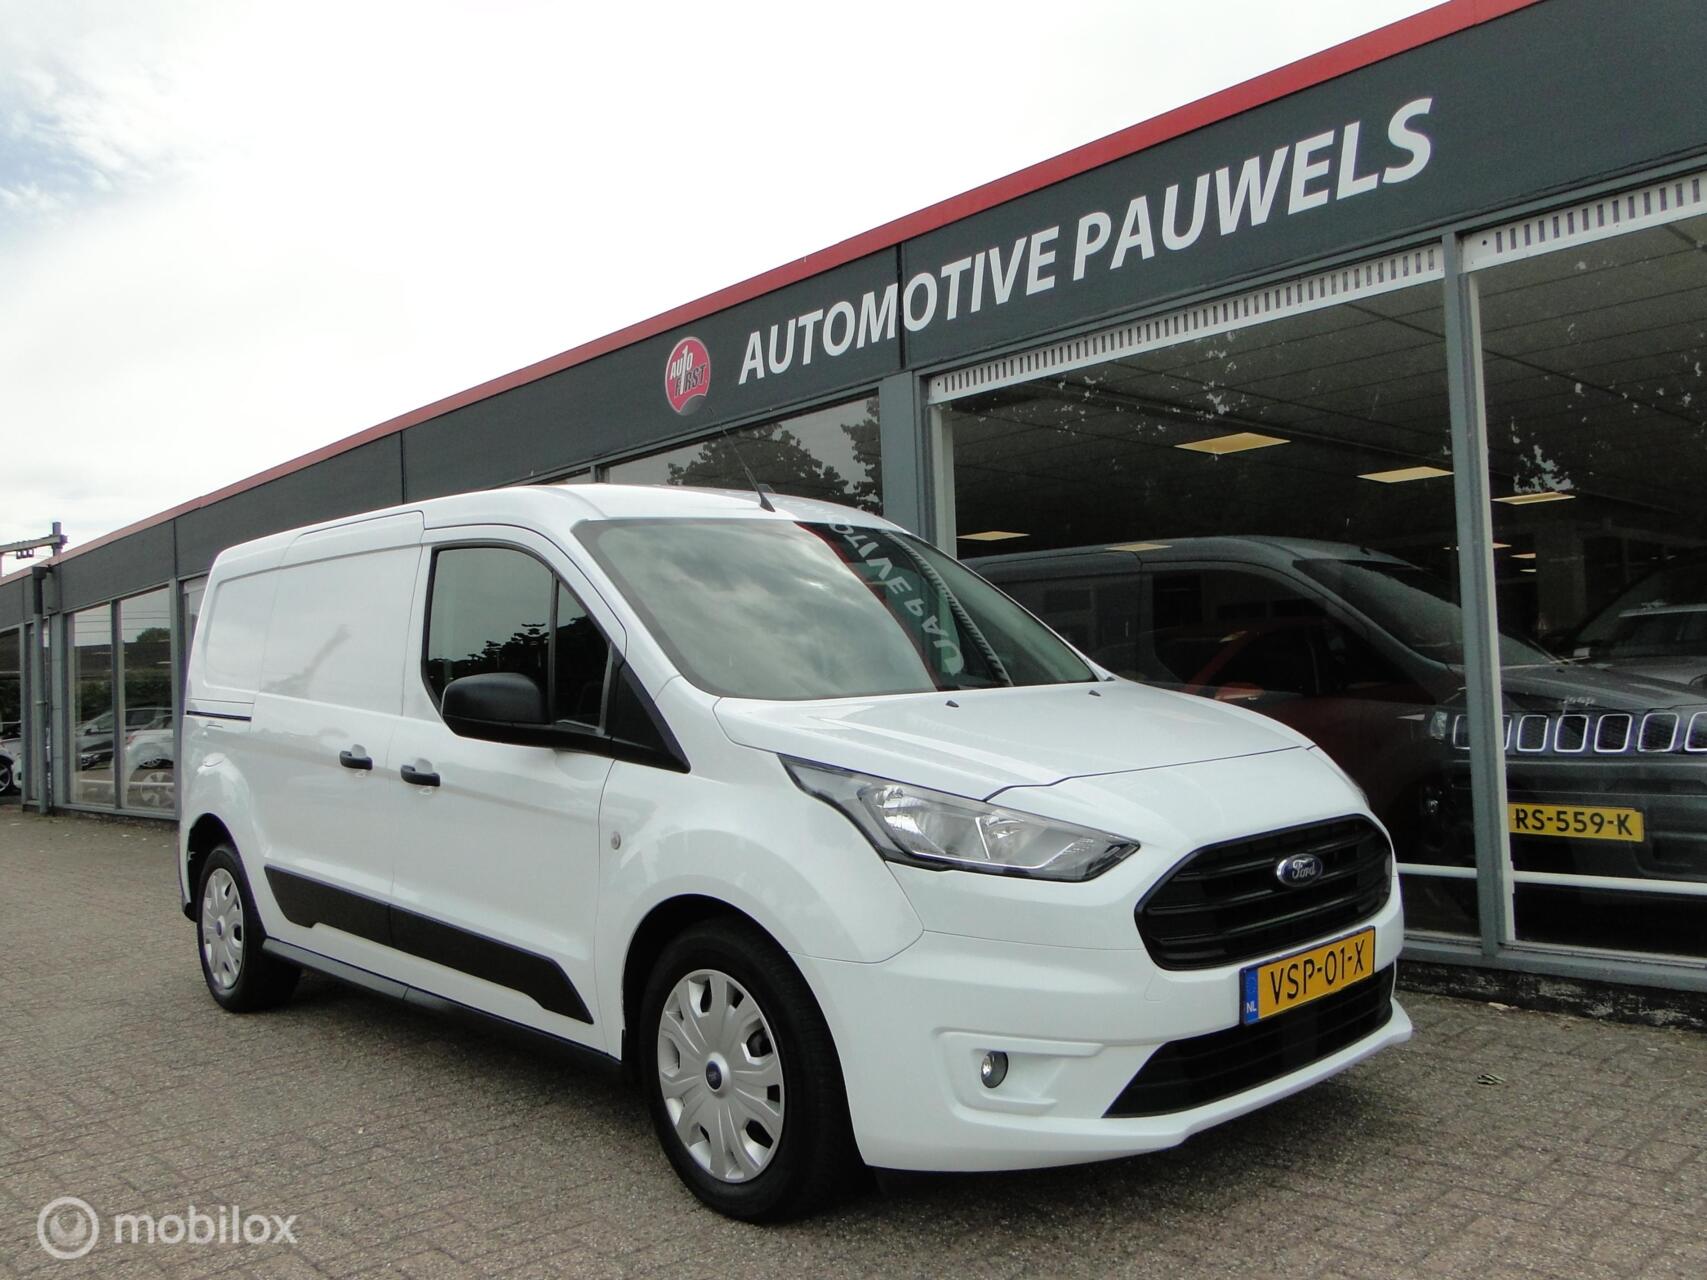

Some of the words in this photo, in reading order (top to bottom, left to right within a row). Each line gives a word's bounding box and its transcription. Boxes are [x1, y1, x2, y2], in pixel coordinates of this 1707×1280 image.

[738, 225, 1060, 385] AUTOMOTIVE
[1072, 97, 1434, 282] PAUWELS
[1515, 807, 1633, 836] RS-559-K
[1291, 857, 1316, 880] Ford
[1270, 939, 1365, 1004] VSP-01-X
[1246, 1000, 1258, 1014] NL
